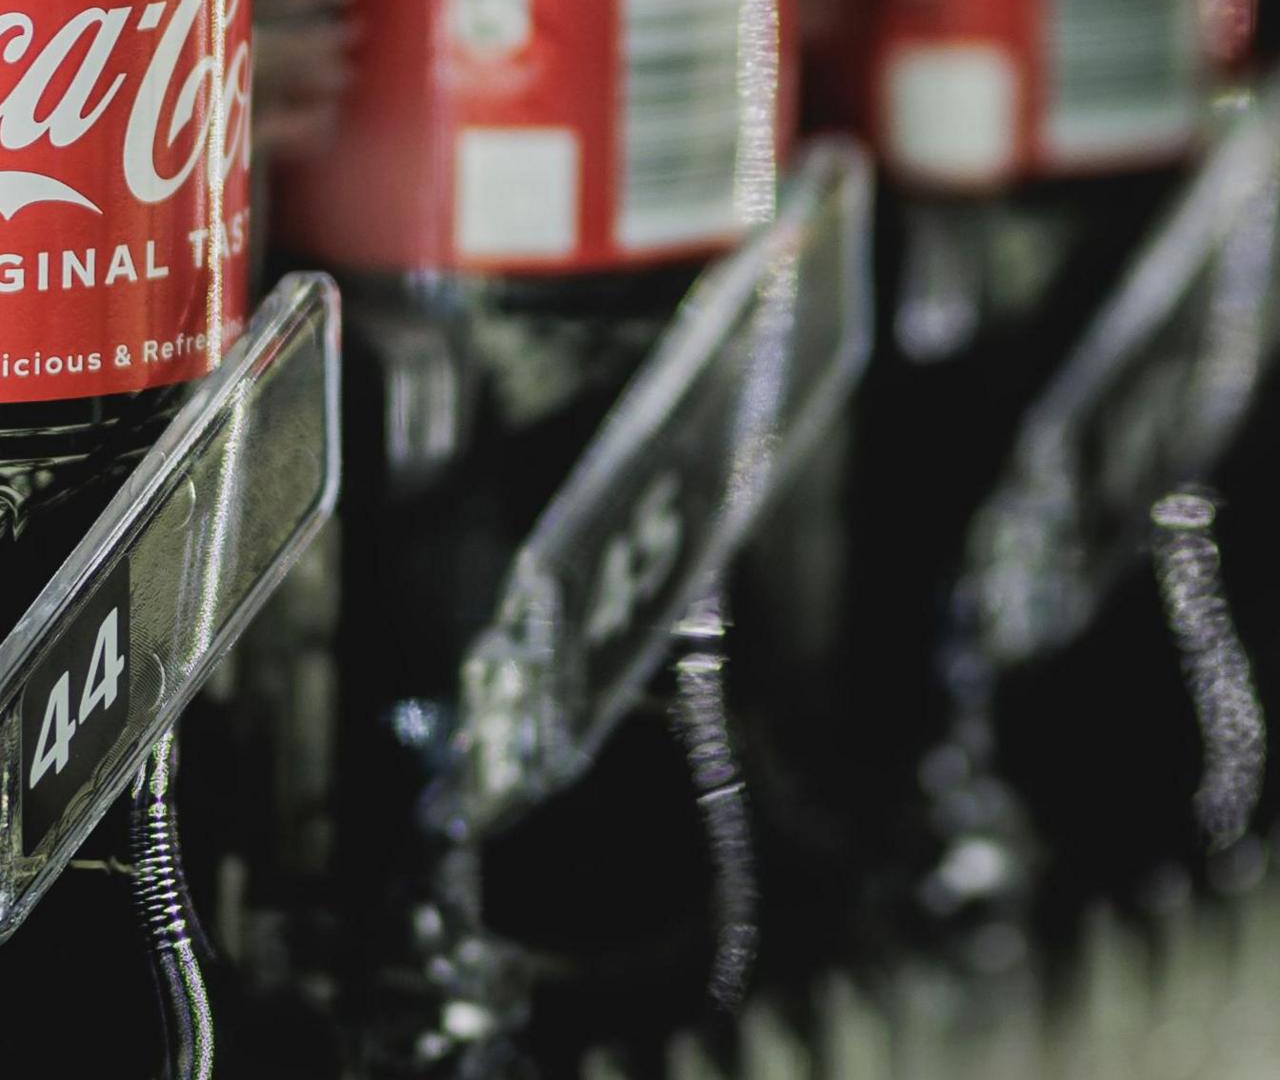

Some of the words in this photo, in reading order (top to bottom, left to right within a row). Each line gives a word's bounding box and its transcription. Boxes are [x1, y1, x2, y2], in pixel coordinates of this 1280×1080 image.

[187, 207, 251, 269] TAS
[114, 343, 132, 367] &
[29, 606, 125, 790] 44
